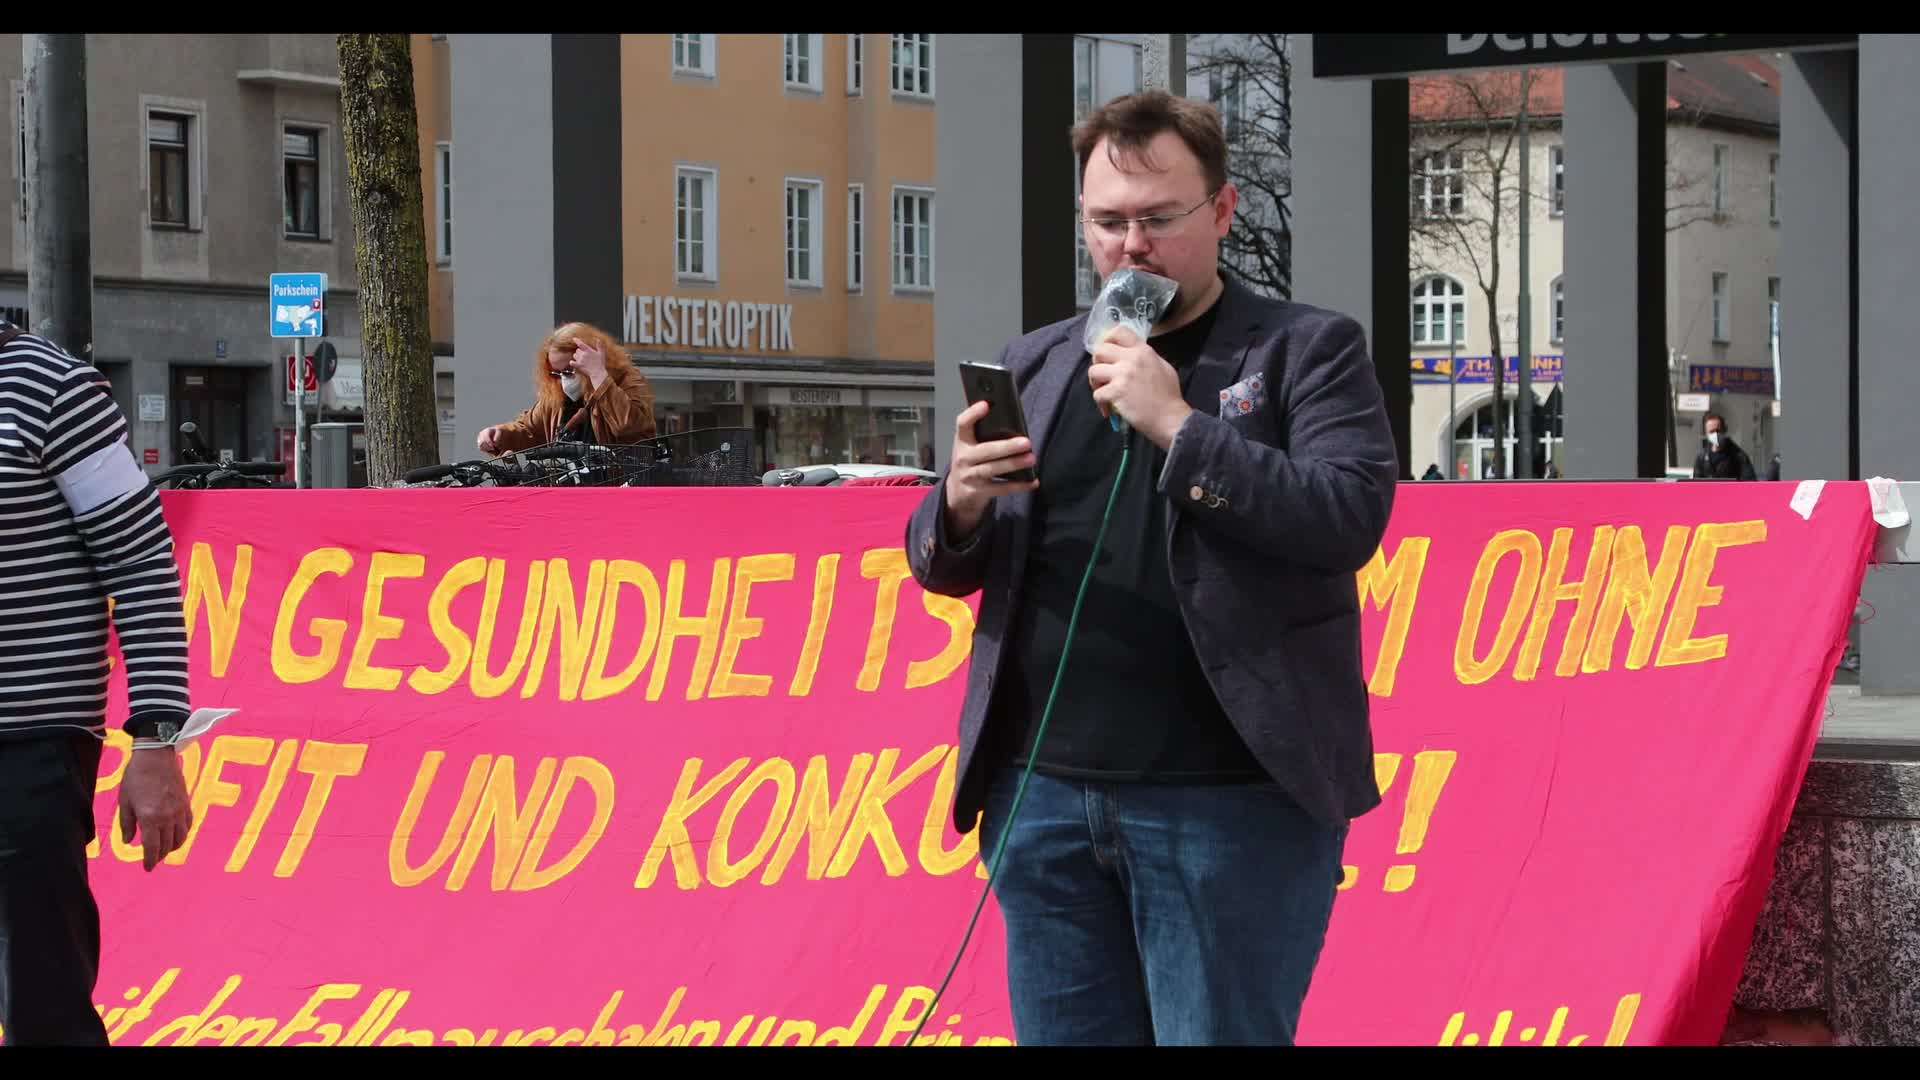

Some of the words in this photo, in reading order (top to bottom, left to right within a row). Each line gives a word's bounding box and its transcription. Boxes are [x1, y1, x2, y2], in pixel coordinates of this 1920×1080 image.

[273, 284, 319, 297] Parkschein
[1465, 360, 1510, 371] THI
[1454, 519, 1768, 684] OHNE
[389, 750, 615, 892] UND
